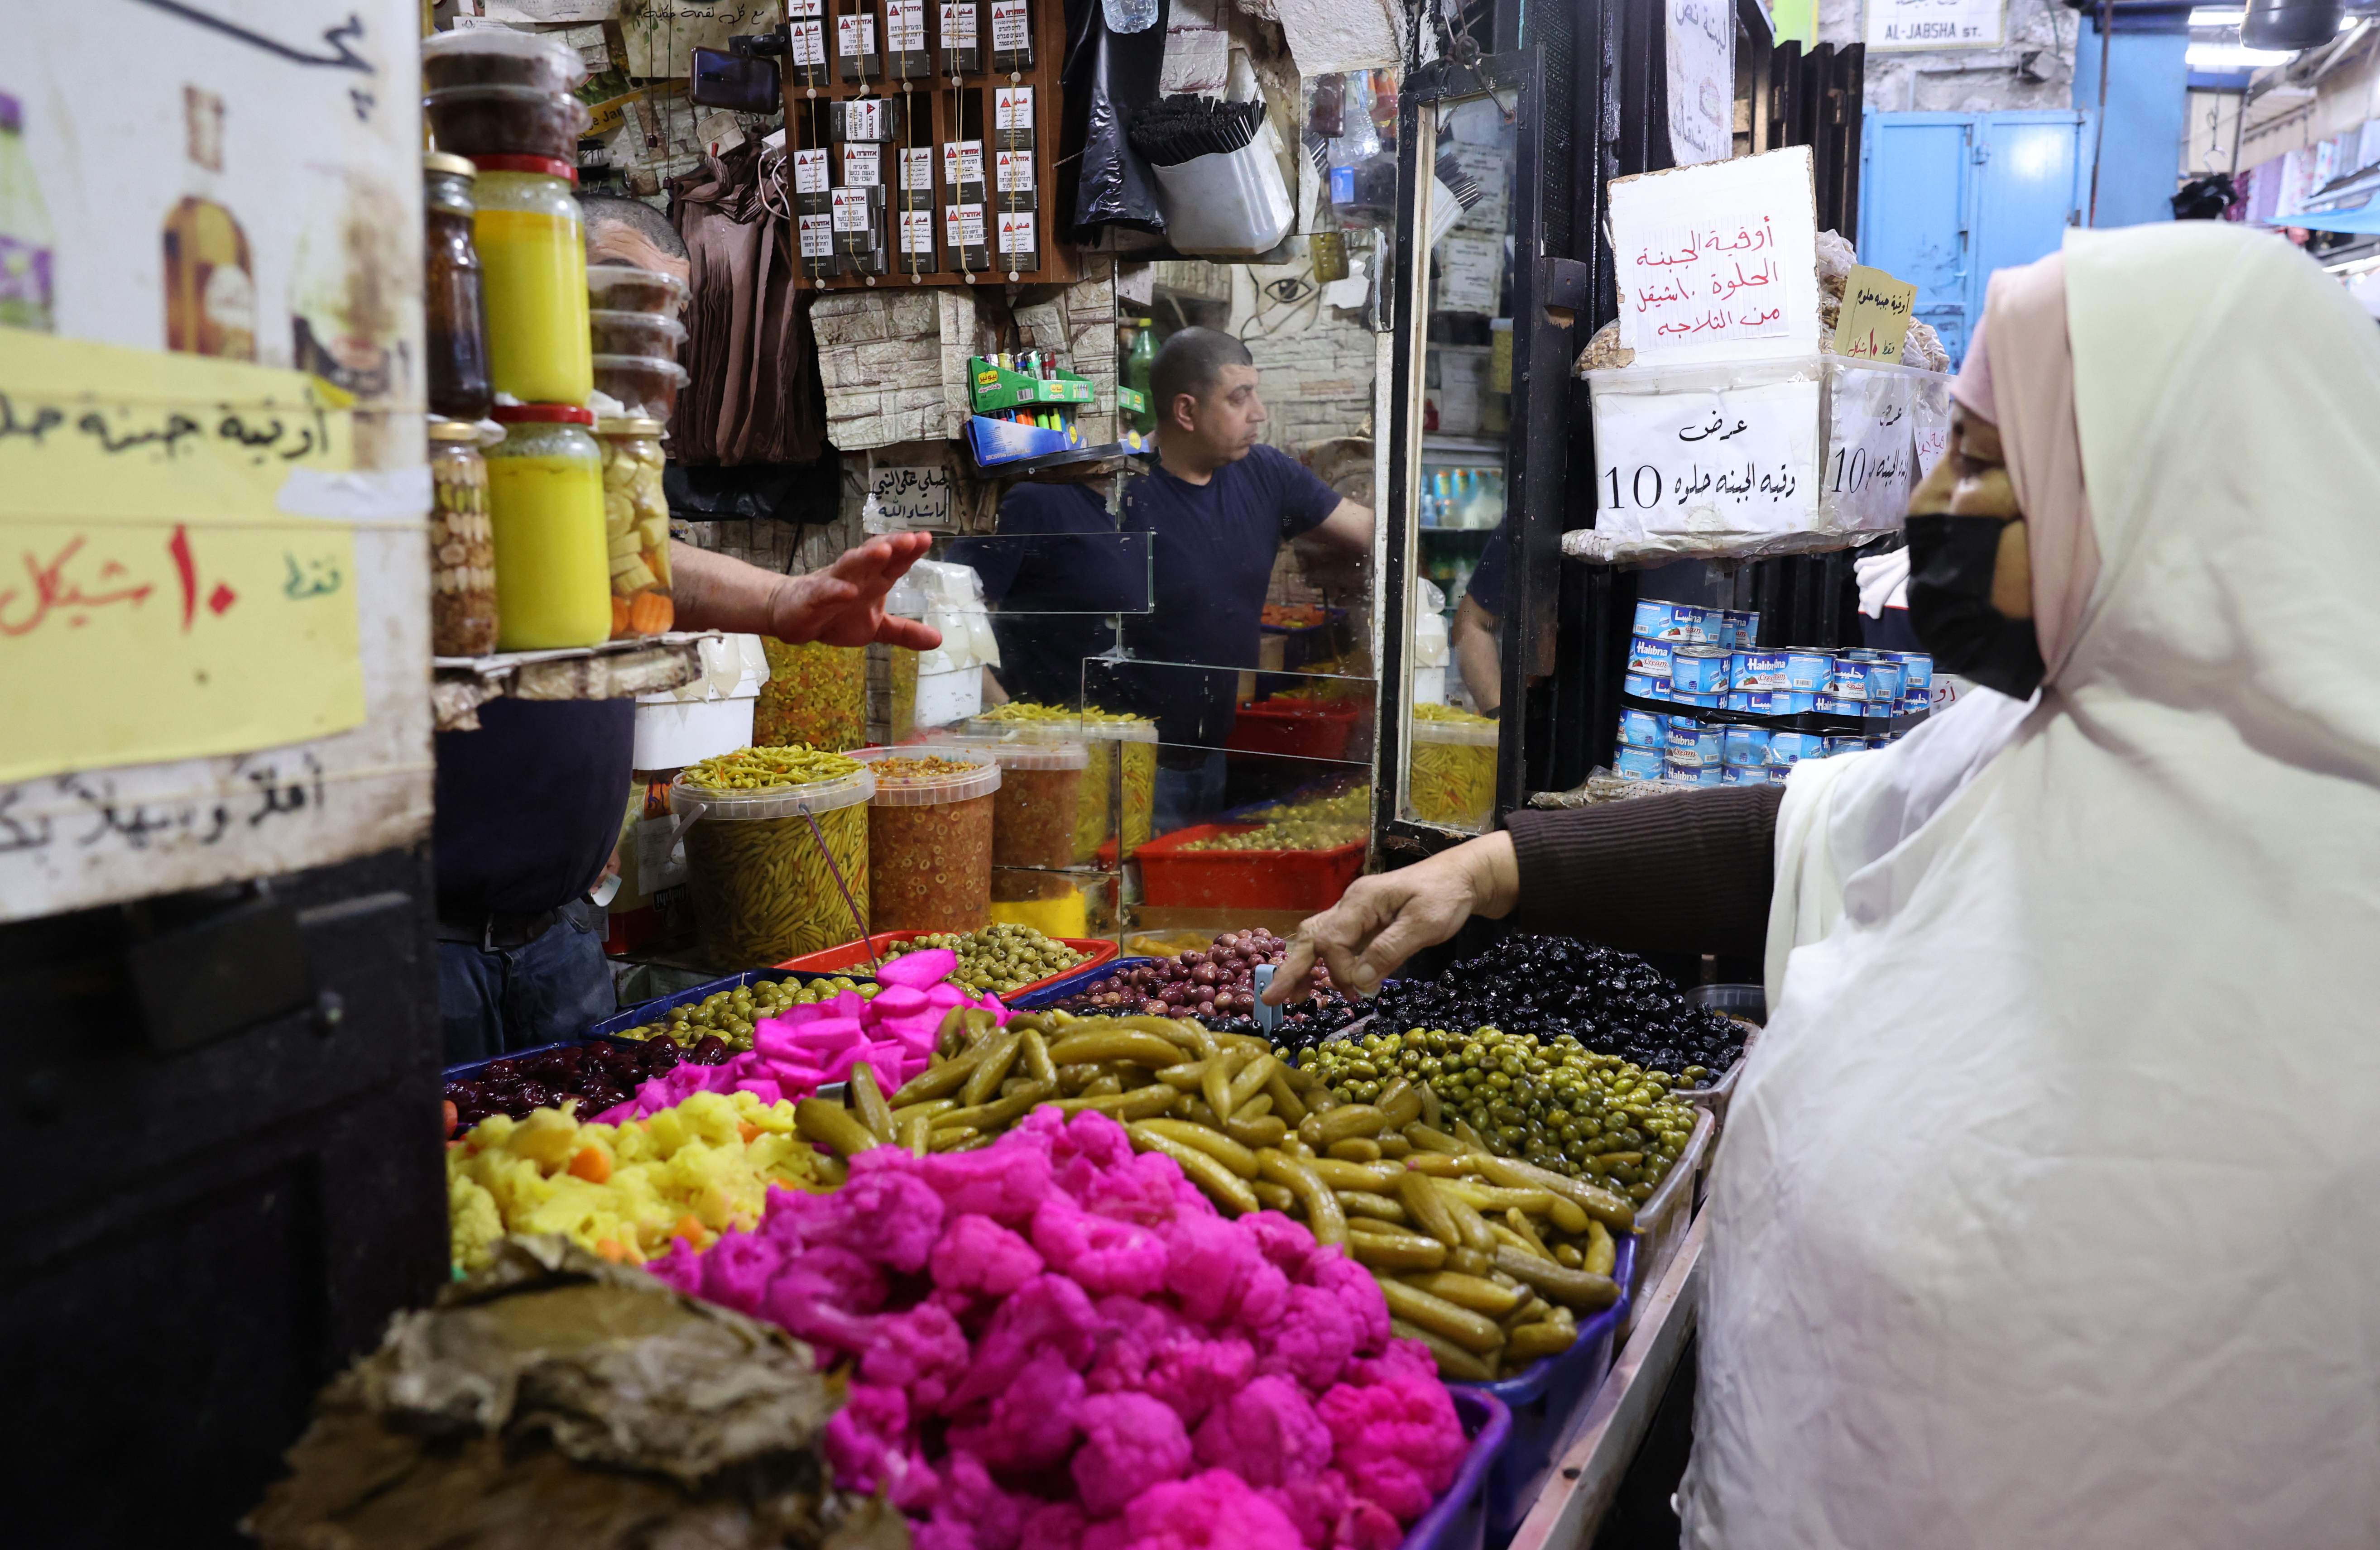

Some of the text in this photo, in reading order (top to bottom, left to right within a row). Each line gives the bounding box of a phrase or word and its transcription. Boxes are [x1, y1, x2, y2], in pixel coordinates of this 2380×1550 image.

[681, 6, 715, 18] لقمة
[751, 11, 764, 25] مع
[1884, 22, 1957, 40] AL-JABSHA
[1636, 215, 1773, 273] أوقية الجبنة
[1712, 257, 1778, 301] الحلوة
[1637, 286, 1677, 312] شيقل
[1740, 306, 1780, 325] من
[1882, 340, 1895, 355] فقط
[1679, 410, 1748, 442] عرض
[1831, 446, 1866, 493] 10
[872, 470, 900, 500] النبي
[896, 469, 917, 495] على
[1605, 464, 1662, 509] 10
[1675, 462, 1711, 506] حلوه
[878, 496, 906, 518] الله
[1636, 641, 1669, 656] Halibna
[1643, 657, 1668, 668] Cream
[1846, 680, 1865, 691] قشطة
[1668, 730, 1695, 746] Halibna
[1674, 746, 1697, 757] Cream
[1667, 766, 1698, 782] Halibna
